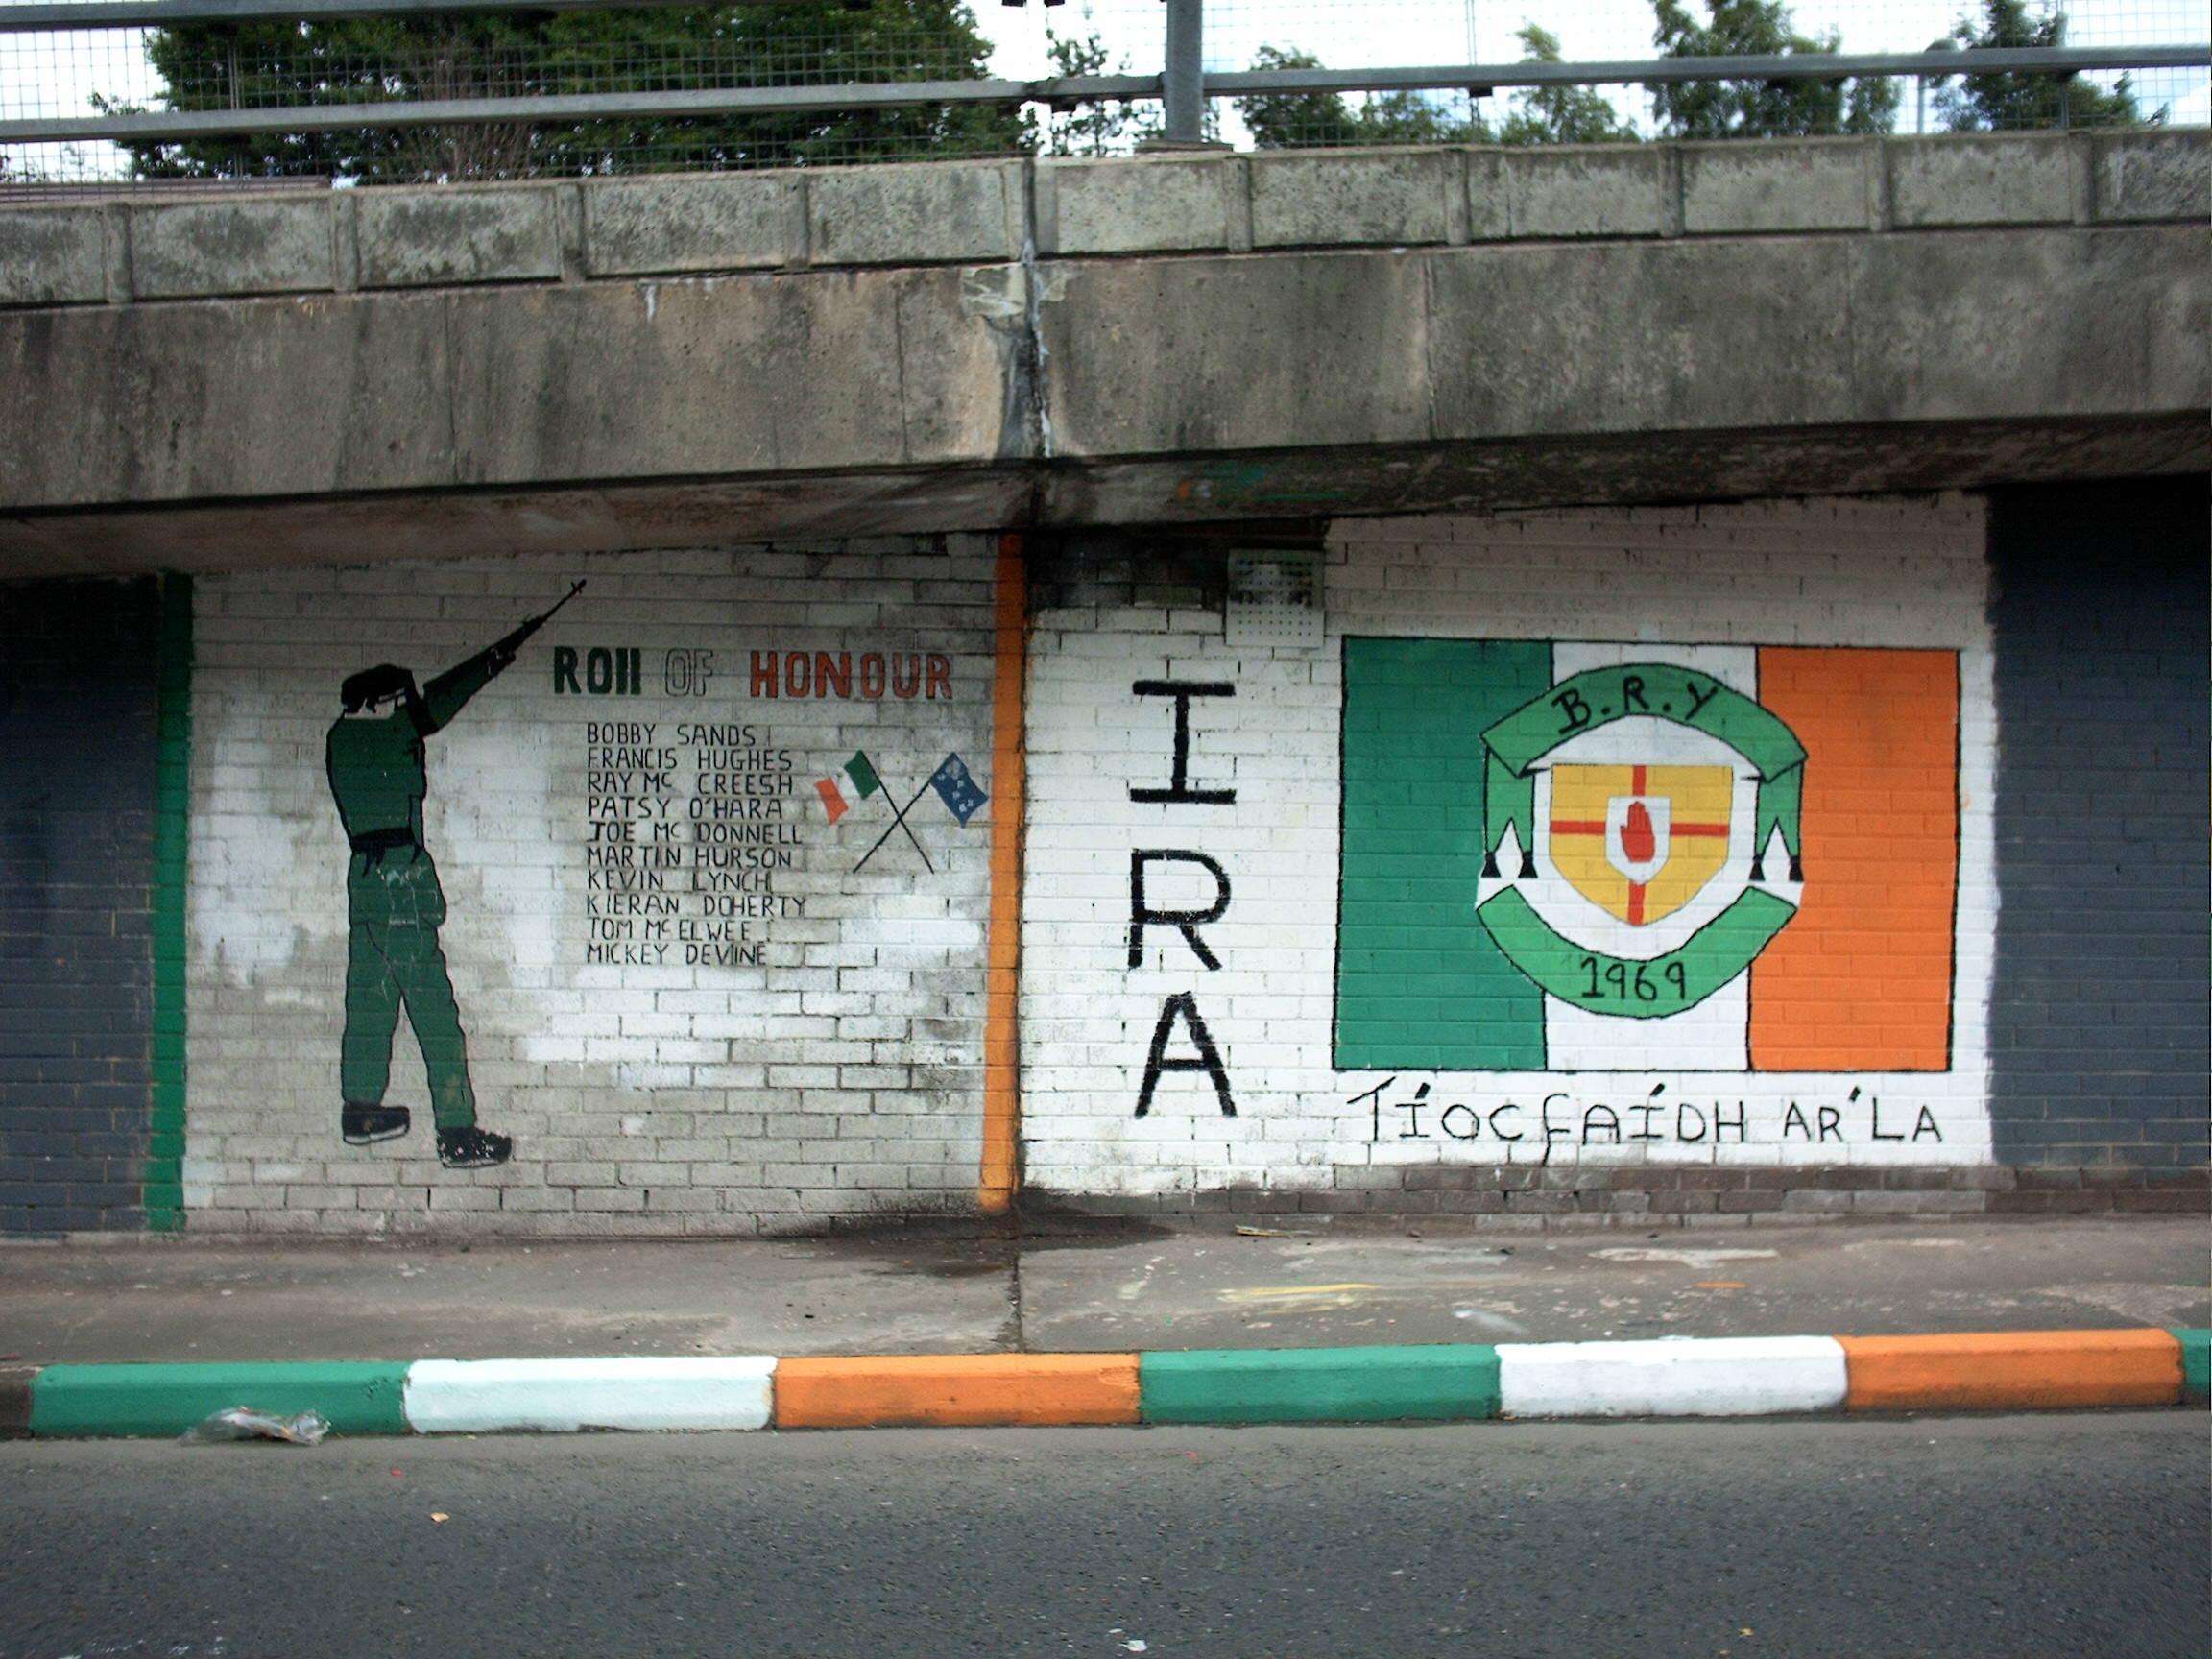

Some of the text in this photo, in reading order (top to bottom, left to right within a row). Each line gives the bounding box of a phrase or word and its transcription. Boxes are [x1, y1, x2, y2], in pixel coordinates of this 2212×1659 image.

[664, 648, 714, 698] OF
[749, 650, 952, 700] HONOUR
[587, 722, 757, 747] BOBBY SANDS
[588, 746, 793, 772] FRANCIS HUGHES
[588, 770, 633, 794] RAY
[697, 772, 793, 796] CREESH
[588, 797, 783, 820] PATSY O'HARA
[586, 821, 637, 843] JOE
[697, 822, 804, 845] DONNELL
[587, 846, 792, 869] MARTIN HURSON
[588, 869, 771, 893] KEVIN LYNCH
[587, 894, 806, 918] KIERAN DOHERTY
[1127, 678, 1238, 1119] IRA
[589, 916, 634, 940] TOM
[587, 943, 767, 966] MICKEY DEVINE
[1579, 957, 1687, 1001] 1969
